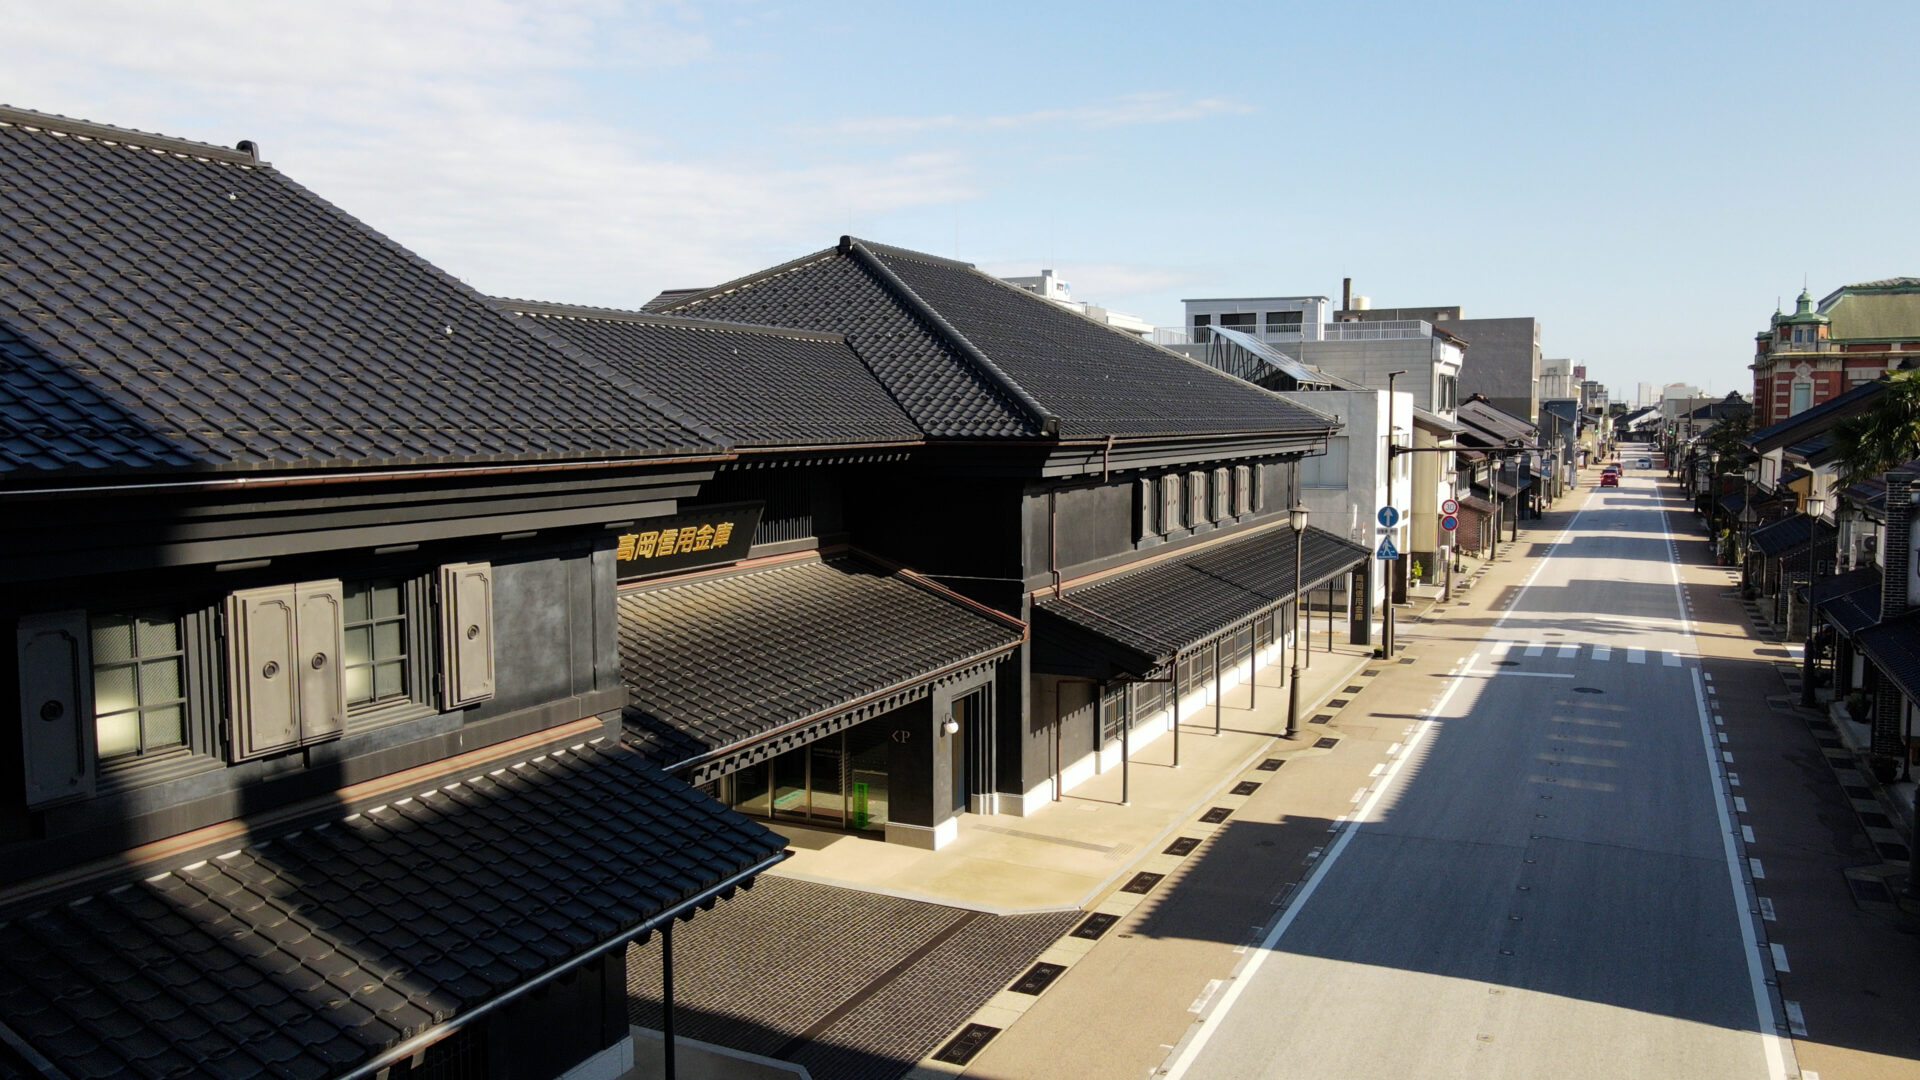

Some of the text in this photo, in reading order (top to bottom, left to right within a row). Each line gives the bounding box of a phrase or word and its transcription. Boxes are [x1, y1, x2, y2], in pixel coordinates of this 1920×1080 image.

[1445, 503, 1455, 511] 30
[616, 521, 734, 561] 高岡信用金庫
